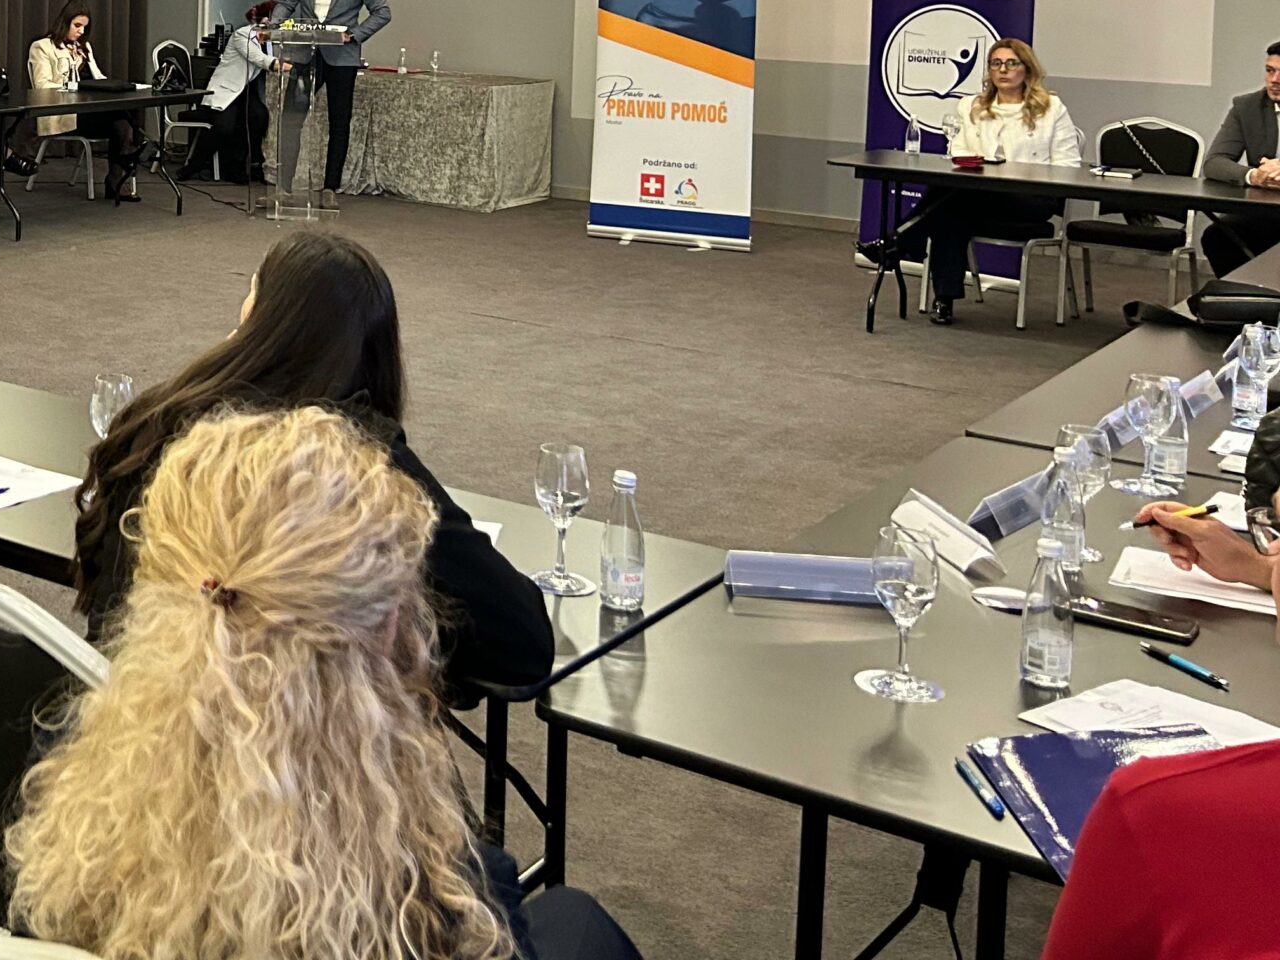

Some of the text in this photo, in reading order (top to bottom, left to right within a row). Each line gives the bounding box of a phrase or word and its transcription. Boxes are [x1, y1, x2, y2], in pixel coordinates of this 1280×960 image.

[908, 55, 946, 64] DIGNITET
[606, 98, 728, 123] PRAVNU POMOĆ
[642, 158, 683, 168] Podržano
